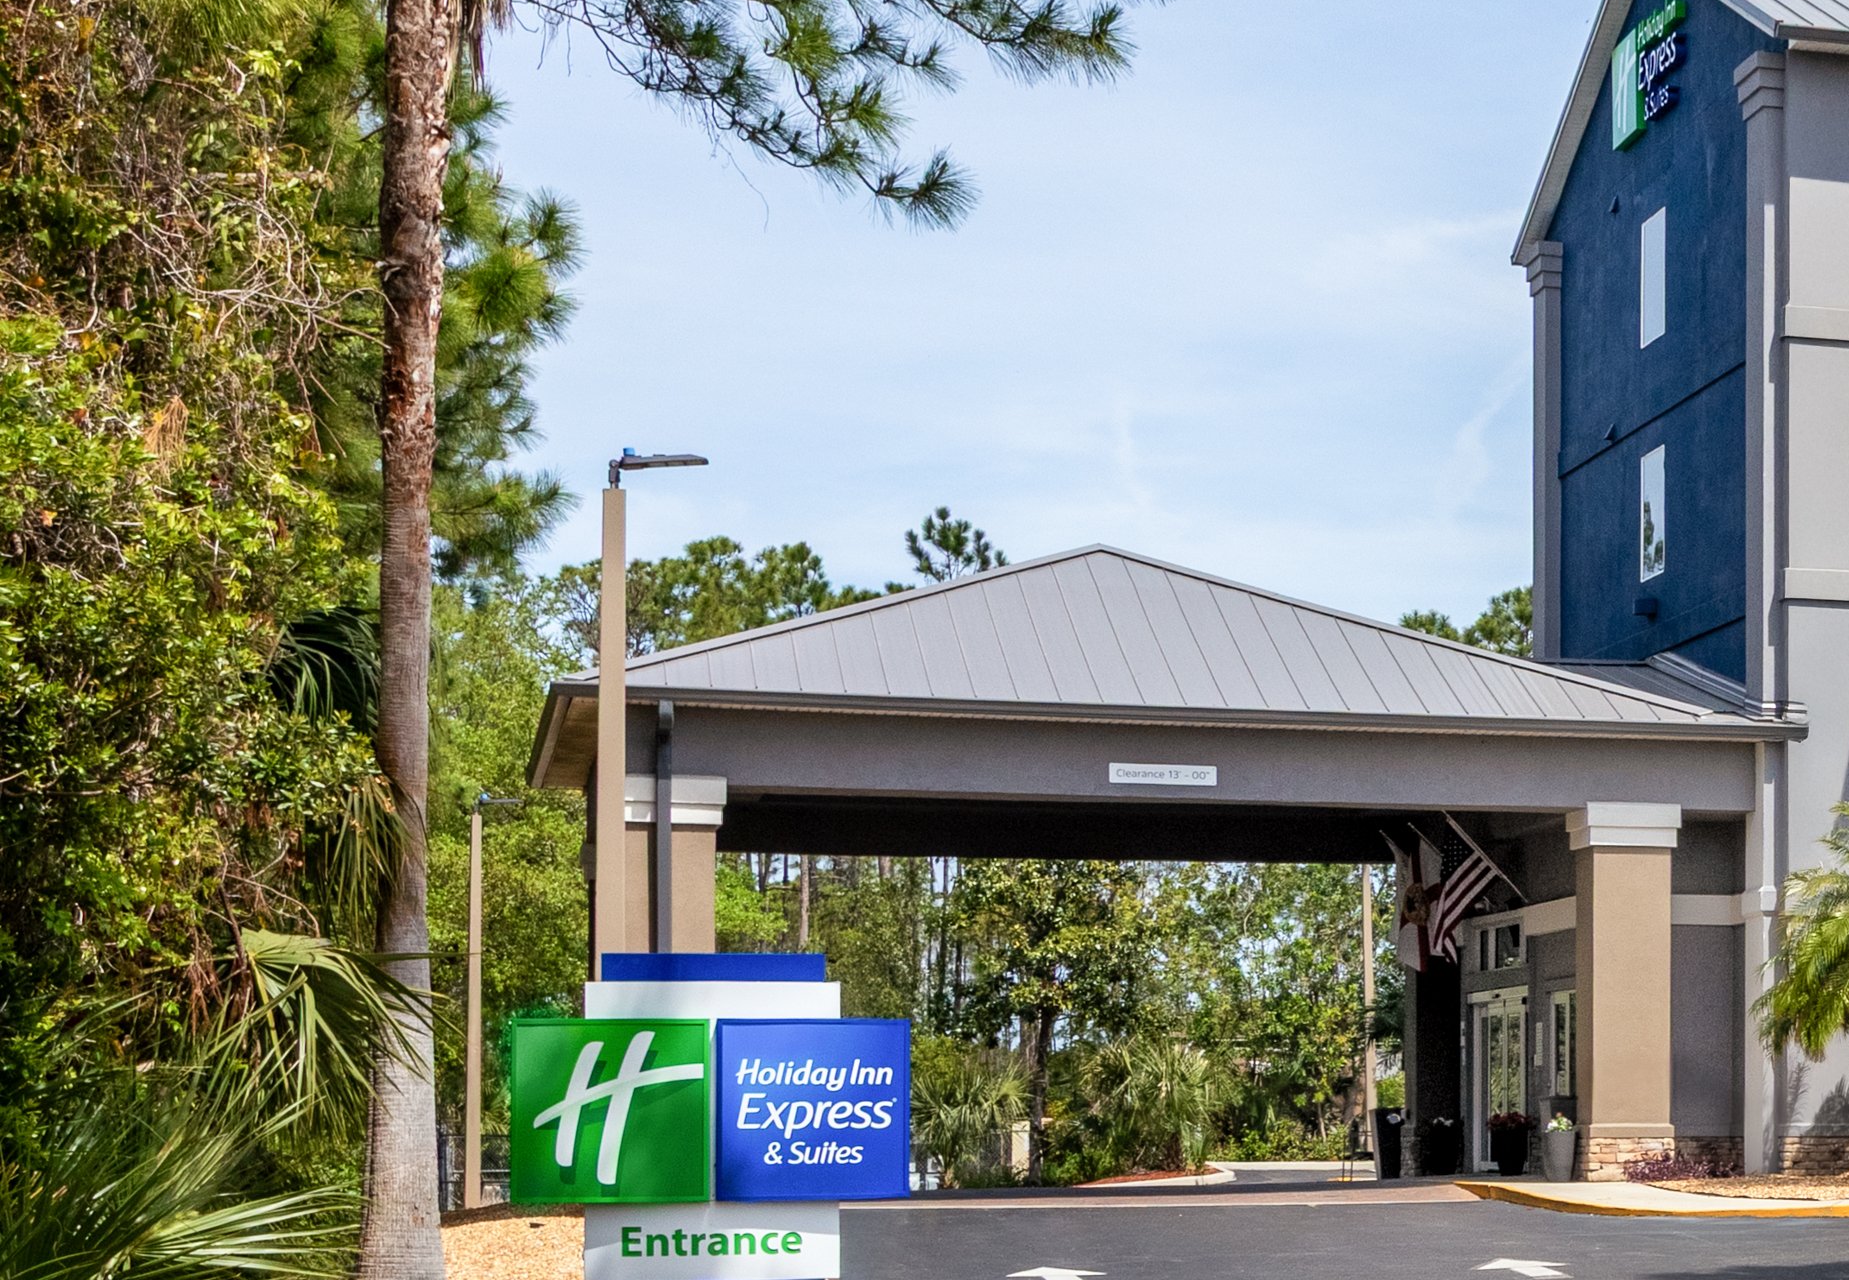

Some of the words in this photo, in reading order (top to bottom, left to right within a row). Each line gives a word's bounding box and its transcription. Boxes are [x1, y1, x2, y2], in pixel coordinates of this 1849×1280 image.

[1637, 9, 1664, 49] Holiday
[1637, 31, 1677, 91] Express
[1116, 768, 1165, 779] Clearance
[735, 1059, 847, 1092] Holiday
[853, 1058, 893, 1085] Inn
[737, 1093, 893, 1139] Express
[763, 1142, 783, 1164] &
[787, 1141, 863, 1165] Suites
[621, 1226, 803, 1258] Entrance
